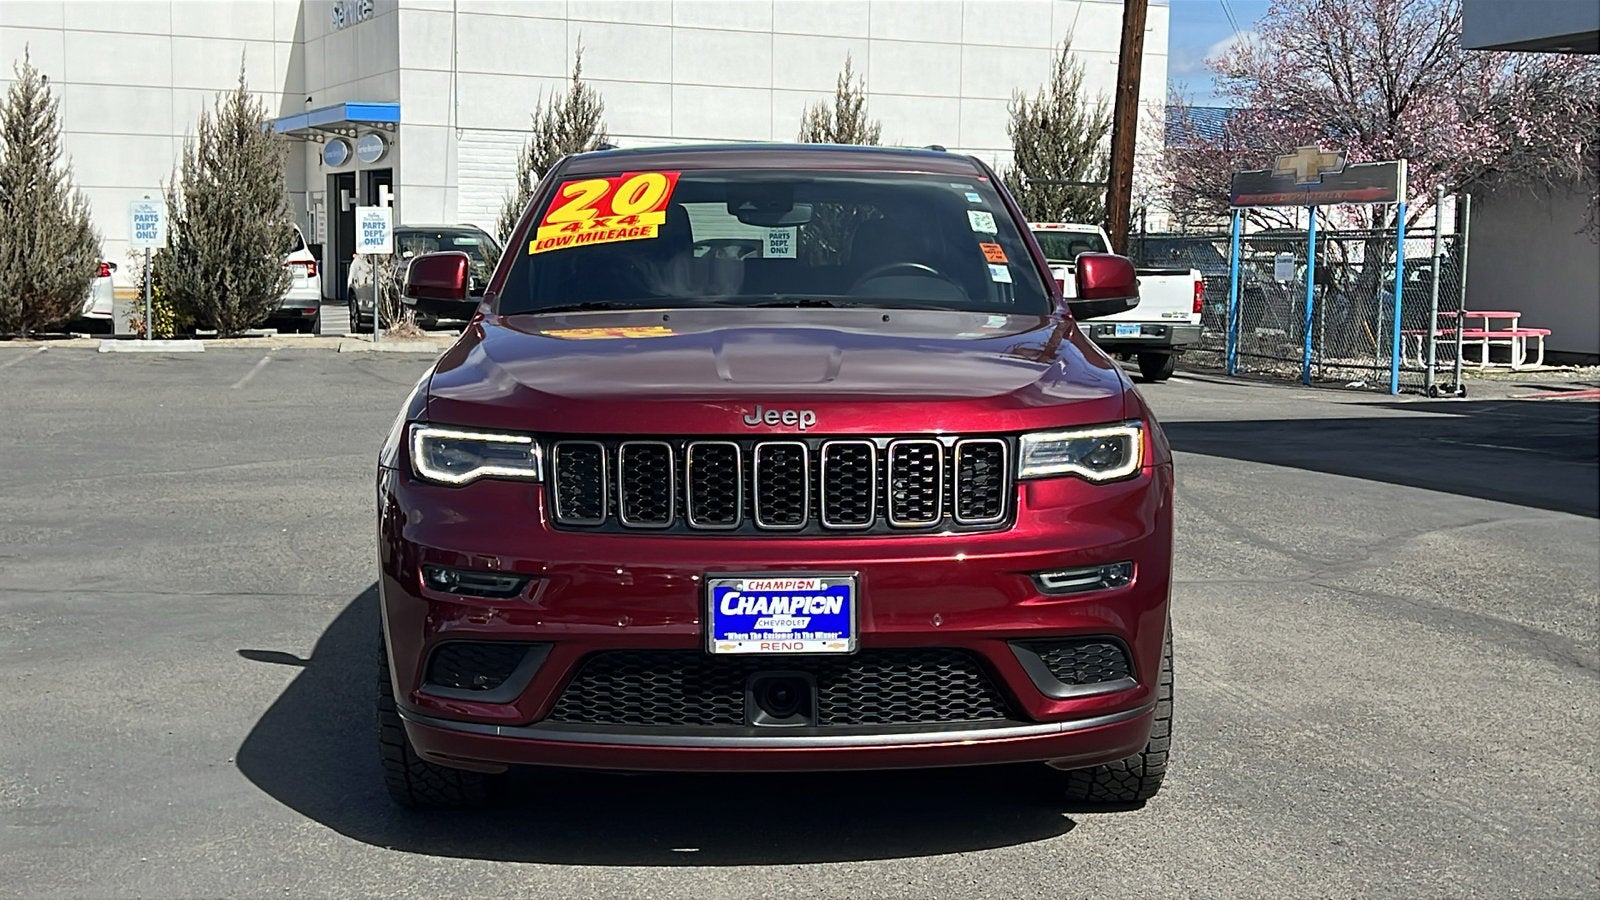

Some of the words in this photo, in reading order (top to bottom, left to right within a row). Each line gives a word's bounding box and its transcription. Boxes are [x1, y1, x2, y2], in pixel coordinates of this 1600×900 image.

[331, 0, 375, 31] Service
[546, 172, 670, 224] 20
[134, 214, 158, 222] PARTS
[362, 222, 386, 230] PARTS
[136, 231, 157, 239] ONLY
[535, 235, 575, 251] LOW
[575, 225, 653, 244] MILEAGE
[743, 404, 817, 430] Jeep
[748, 580, 815, 591] CHAMPION
[719, 591, 844, 616] CHAMPION
[758, 619, 806, 627] CHEVROLET
[760, 642, 804, 651] RENO
